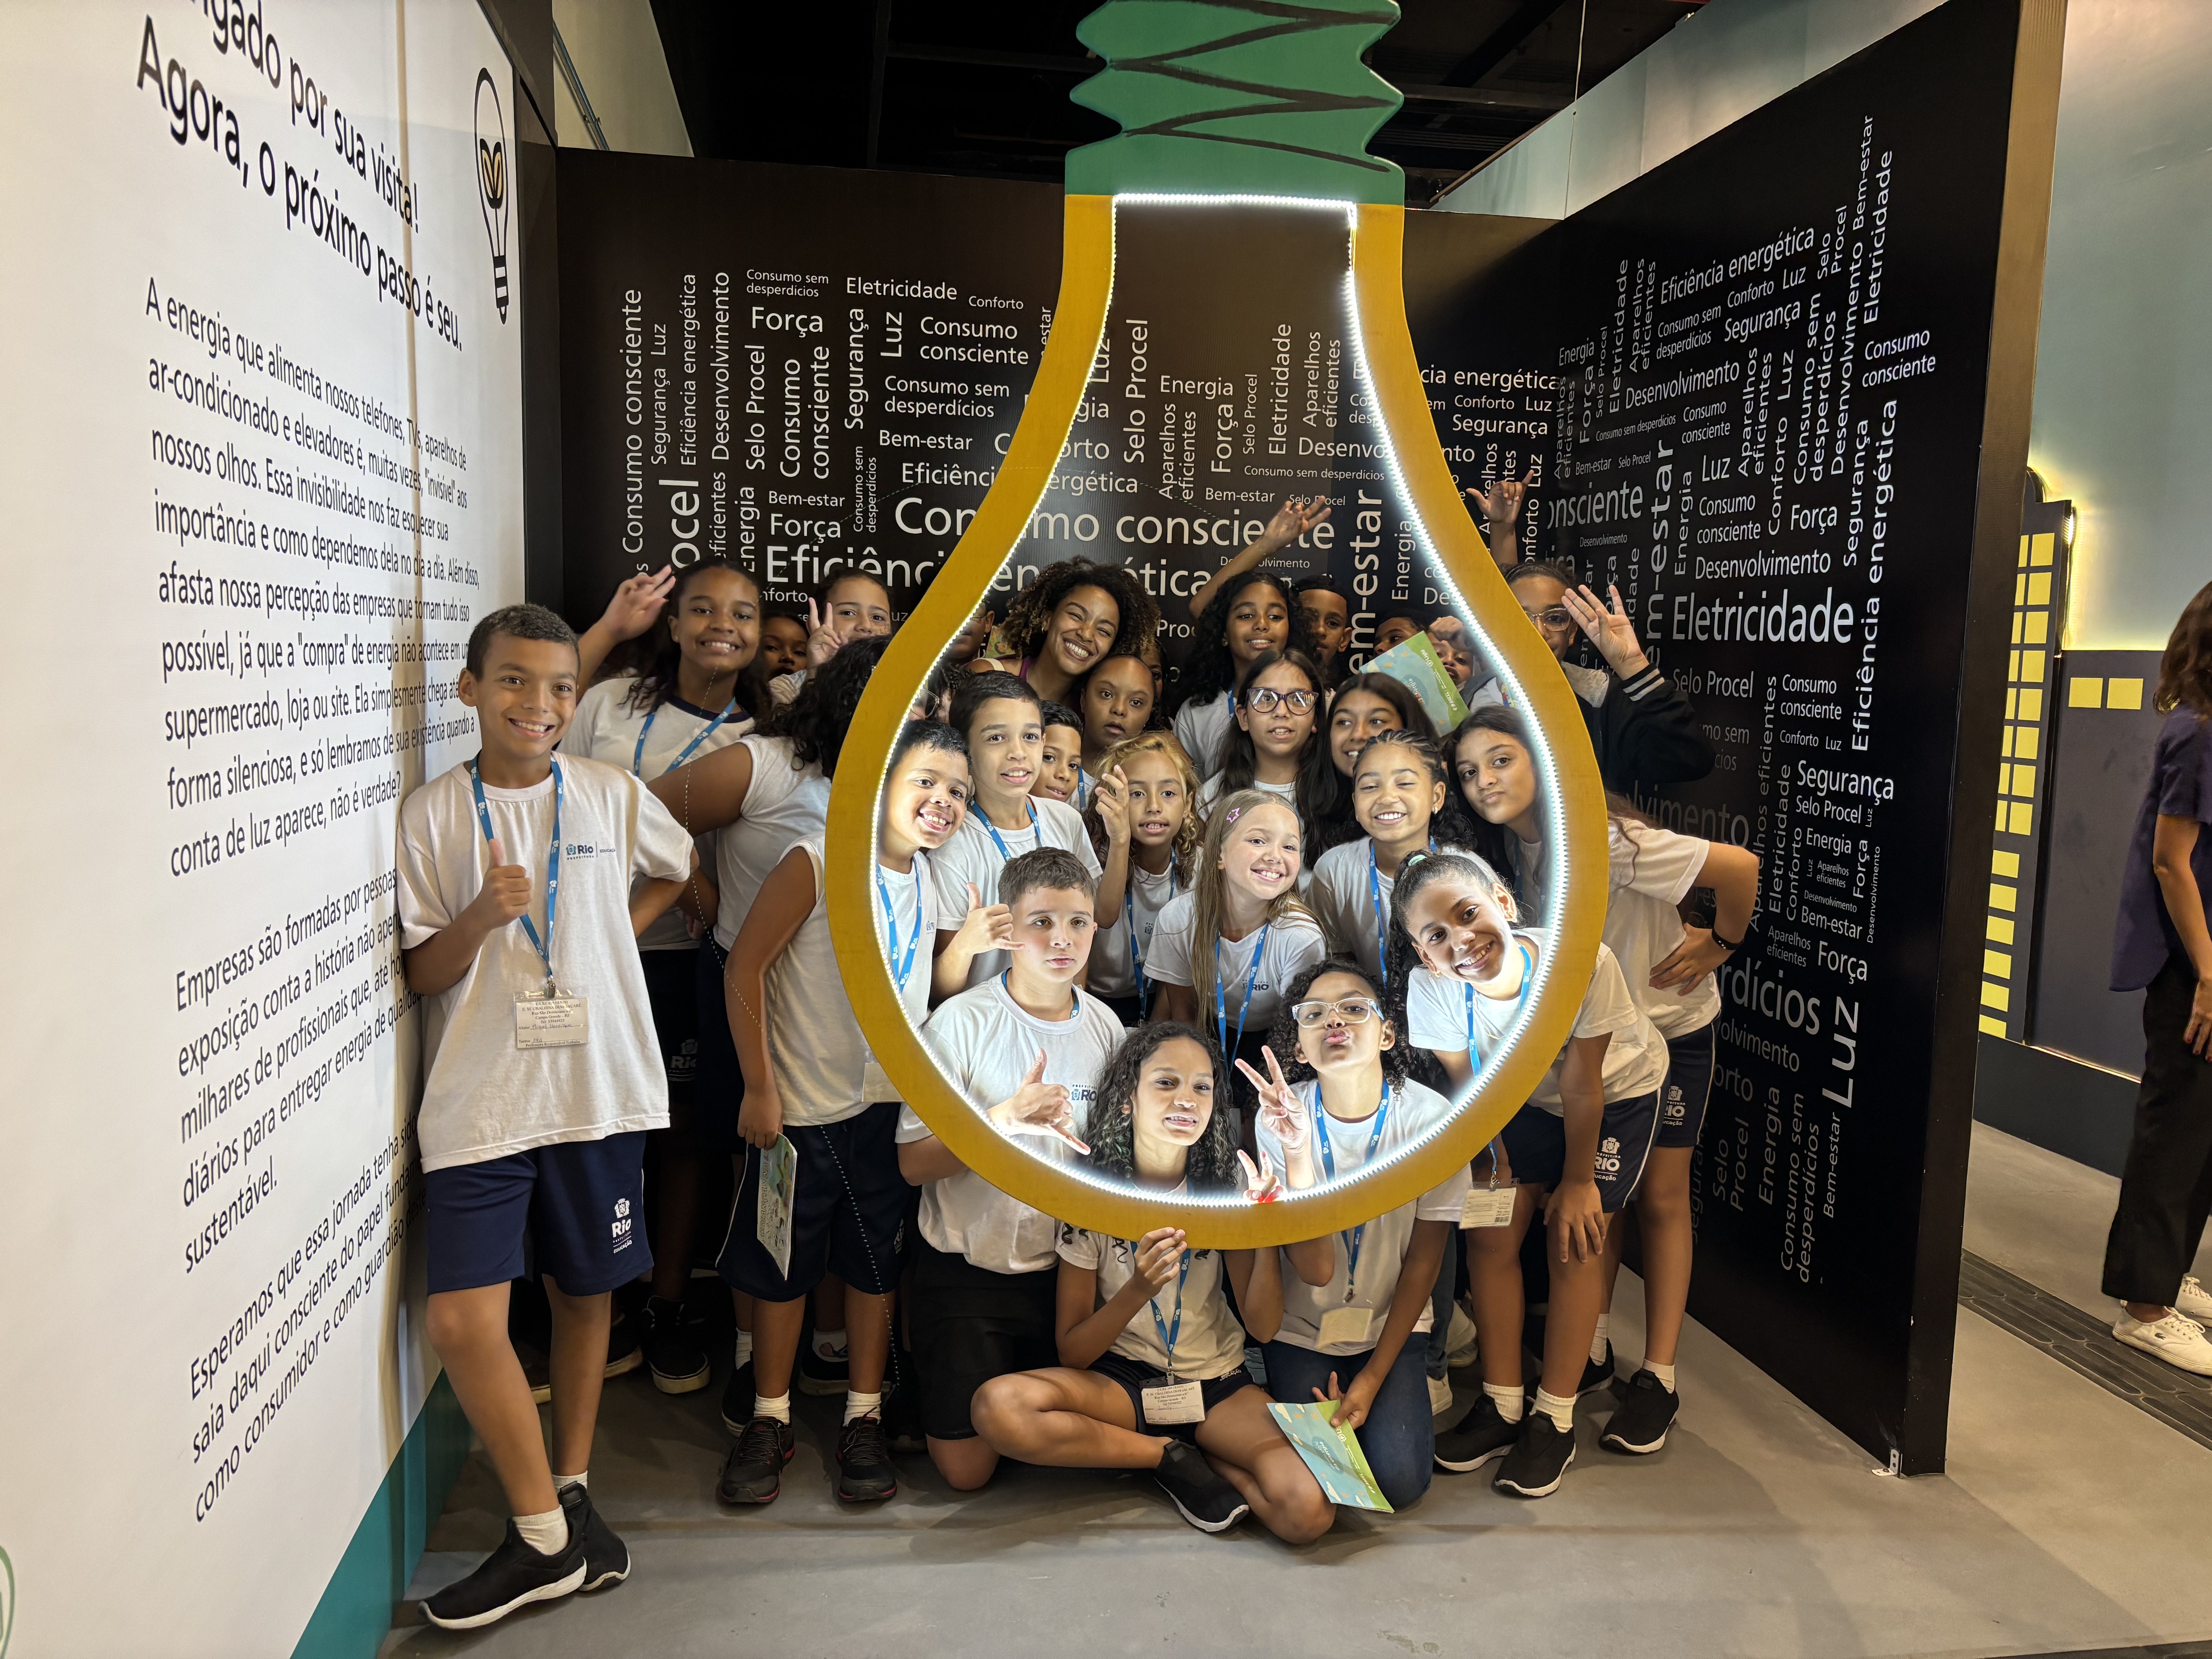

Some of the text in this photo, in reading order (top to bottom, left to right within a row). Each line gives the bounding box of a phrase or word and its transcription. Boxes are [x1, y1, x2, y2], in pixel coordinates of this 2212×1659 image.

[290, 57, 327, 137] por
[335, 109, 366, 180] sua
[371, 143, 418, 234] visita!
[1853, 116, 1872, 230] Bem-estar
[137, 15, 462, 351] Agora, o próximo passo é seu.
[1661, 227, 1814, 304] Eficiência energética
[1817, 234, 1830, 279] Selo
[1831, 206, 1846, 273] Procel
[1861, 151, 1892, 324] Eletricidade
[747, 270, 828, 283] Consumo sem
[747, 283, 818, 297] desperdícios
[847, 277, 957, 299] Eletricidade
[969, 296, 1023, 309] Conforto
[651, 324, 666, 355] Luz
[752, 307, 822, 337] Força
[881, 312, 902, 357] Luz
[921, 317, 1017, 339] Consumo
[1610, 260, 1627, 413] Eletricidade
[1630, 259, 1644, 373] Aparelhos
[1641, 262, 1655, 369] eficientes
[1724, 302, 1800, 342] Segurança
[146, 277, 405, 446] A energia que alimenta nossos telefones,
[679, 275, 700, 465] Eficiência energética
[710, 273, 729, 460] Desenvolvimento
[845, 309, 869, 429] Segurança
[921, 344, 1028, 364] consciente
[1559, 338, 1594, 366] Energia
[1863, 355, 1936, 387] consciente
[1865, 331, 1930, 362] Consumo
[745, 345, 764, 469] Selo Procel
[885, 376, 1009, 397] Consumo sem
[885, 396, 994, 417] desperdícios
[1123, 320, 1147, 462] Selo Procel
[1161, 375, 1233, 399] Energia
[1268, 325, 1291, 454] Eletricidade
[1454, 370, 1560, 392] energética
[1455, 395, 1552, 411] Conforto Luz
[1580, 366, 1595, 443] Força
[1626, 360, 1739, 410] Desenvolvimento
[1794, 293, 1822, 484] Consumo sem
[149, 359, 278, 436] ar-condicionado
[295, 412, 354, 465] elevadores
[620, 290, 643, 553] Consumo consciente
[651, 369, 670, 464] Segurança
[780, 359, 800, 477] Consumo
[808, 347, 829, 479] consciente
[880, 430, 972, 450] Bem-estar
[1211, 405, 1238, 472] Força
[1243, 374, 1257, 454] Selo Procel
[1453, 414, 1547, 438] Segurança
[1637, 415, 1676, 436] desperdícios
[153, 430, 365, 519] nossos olhos. Essa invisibilidade
[903, 463, 995, 486] Eficiênci
[1159, 403, 1177, 500] Aparelhos
[1178, 412, 1196, 502] eficientes
[1321, 468, 1384, 481] desperdícios
[1576, 458, 1611, 475] Bem-estar
[1619, 451, 1650, 468] Selo Procel
[1702, 455, 1730, 481] Luz
[769, 491, 845, 507] Bem-estar
[854, 446, 863, 532] Consumo sem
[866, 458, 878, 532] desperdícios
[1206, 488, 1275, 502] Bem-estar
[1700, 495, 1755, 516] Consumo
[155, 488, 378, 570] importância dependemos
[659, 479, 700, 569] ocel
[1791, 505, 1837, 534] Força
[160, 561, 329, 621] afasta nossa percepção
[1696, 549, 1831, 579] Desenvolvimento
[1852, 400, 1896, 750] Eficiência energética
[1673, 587, 1853, 643] Eletricidade
[163, 630, 348, 684] possível, "compra"
[1707, 671, 1753, 697] Procel
[165, 680, 425, 749] supermercado, simplesmente
[1780, 730, 1841, 750] Conforto Luz
[167, 750, 295, 809] forma silenciosa,
[1798, 760, 1893, 805] Segurança
[172, 770, 400, 876] conta luz aparece, verdade?
[1824, 800, 1861, 823] Procel
[577, 845, 593, 854] Rio
[1807, 828, 1851, 856] Energia
[1817, 860, 1849, 876] Aparelhos
[1853, 840, 1869, 898] Força
[1805, 890, 1856, 912] Desenvolvimento
[1817, 873, 1846, 888] eficientes
[1802, 906, 1862, 939] Bem-estar
[177, 895, 340, 1013] Empresas formadas
[1819, 941, 1867, 984] Força
[179, 998, 258, 1076] exposição
[182, 989, 348, 1144] milhares profissionais
[1822, 996, 1858, 1108] Luz
[184, 1058, 331, 1207] diários para entregar
[1759, 1087, 1781, 1205] Energia
[1781, 1094, 1803, 1270] Consumo sem
[1824, 1112, 1840, 1218] Bem-estar
[184, 1153, 276, 1273] sustentável.
[612, 1219, 631, 1238] Rio
[1796, 1123, 1819, 1283] desperdícios
[191, 1165, 371, 1401] Esperamos jornada
[194, 1262, 339, 1463] saia consciente
[196, 1219, 404, 1522] como consumidor guardião
